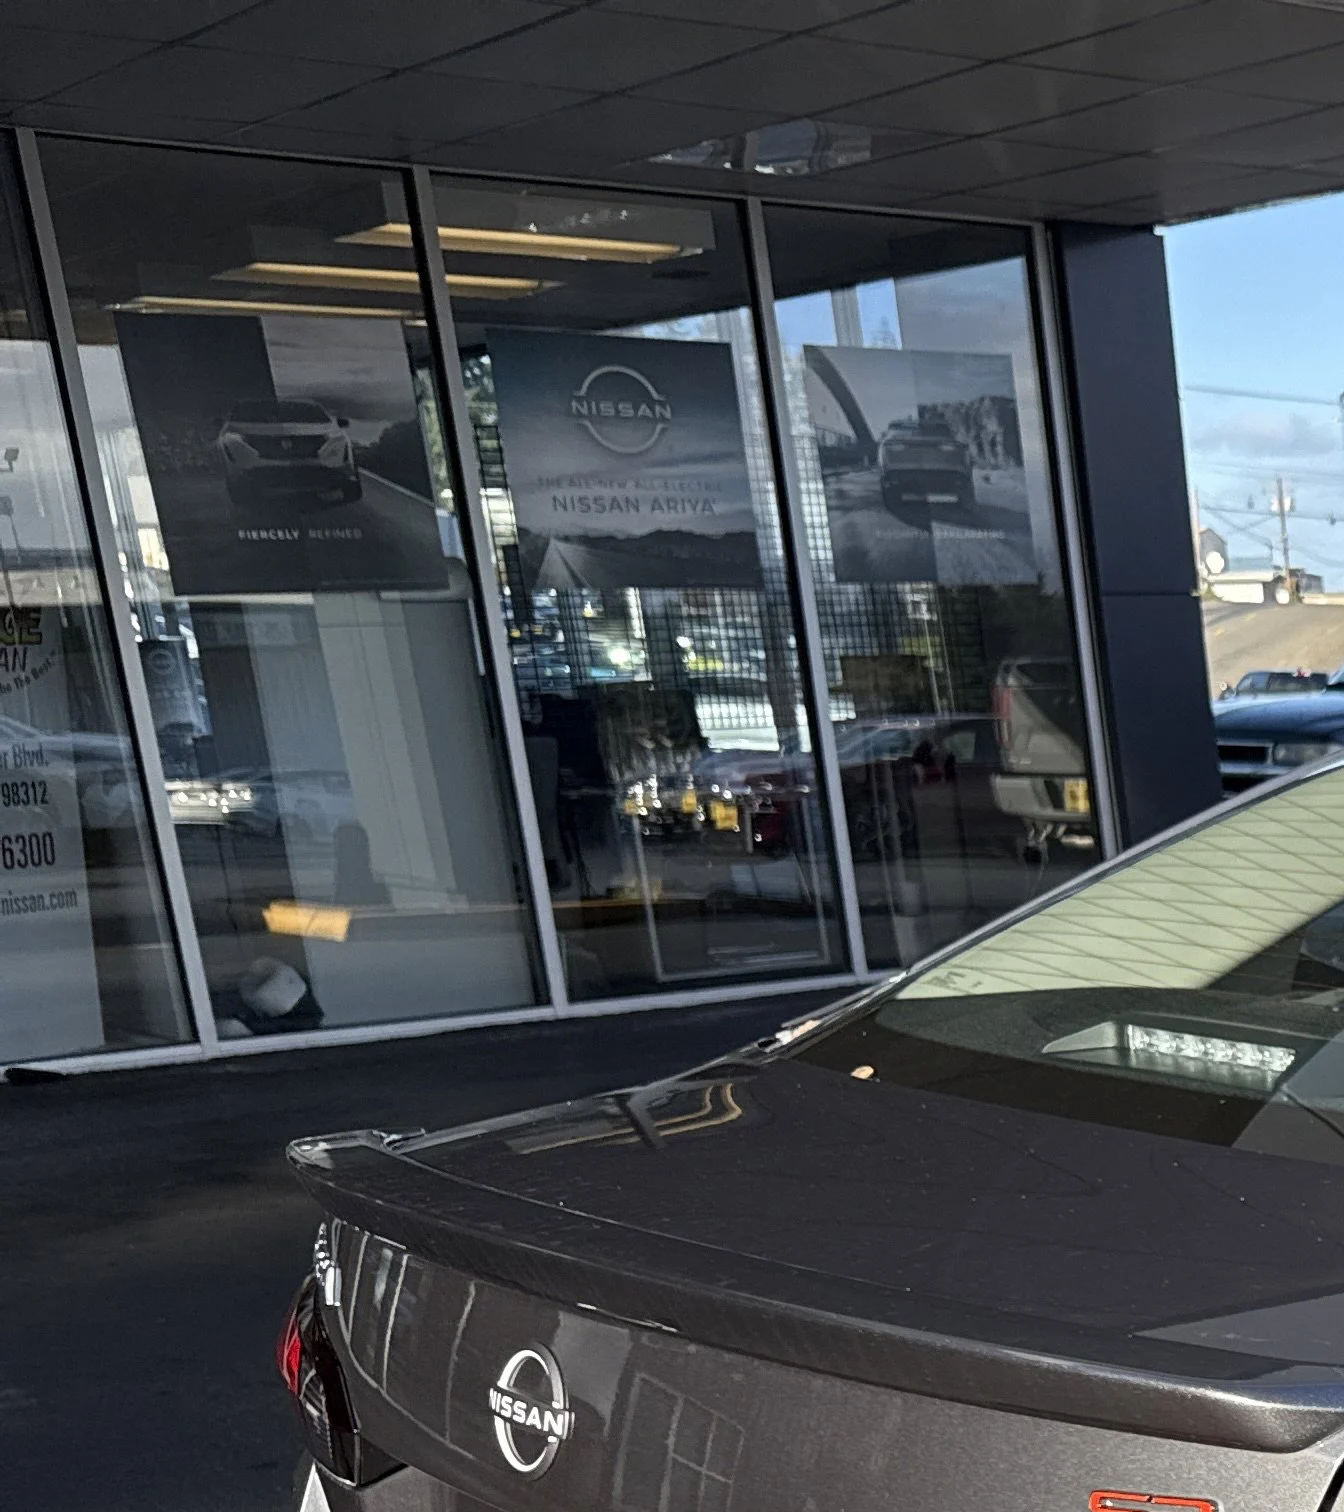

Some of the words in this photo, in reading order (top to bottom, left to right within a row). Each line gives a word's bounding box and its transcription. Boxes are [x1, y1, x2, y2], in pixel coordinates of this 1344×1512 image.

[571, 400, 672, 420] NISSAN
[552, 495, 640, 513] NISSAN
[651, 497, 716, 516] ARIYA
[12, 743, 49, 769] Blvd.
[2, 780, 49, 808] 98312
[488, 1387, 564, 1436] NISSAN
